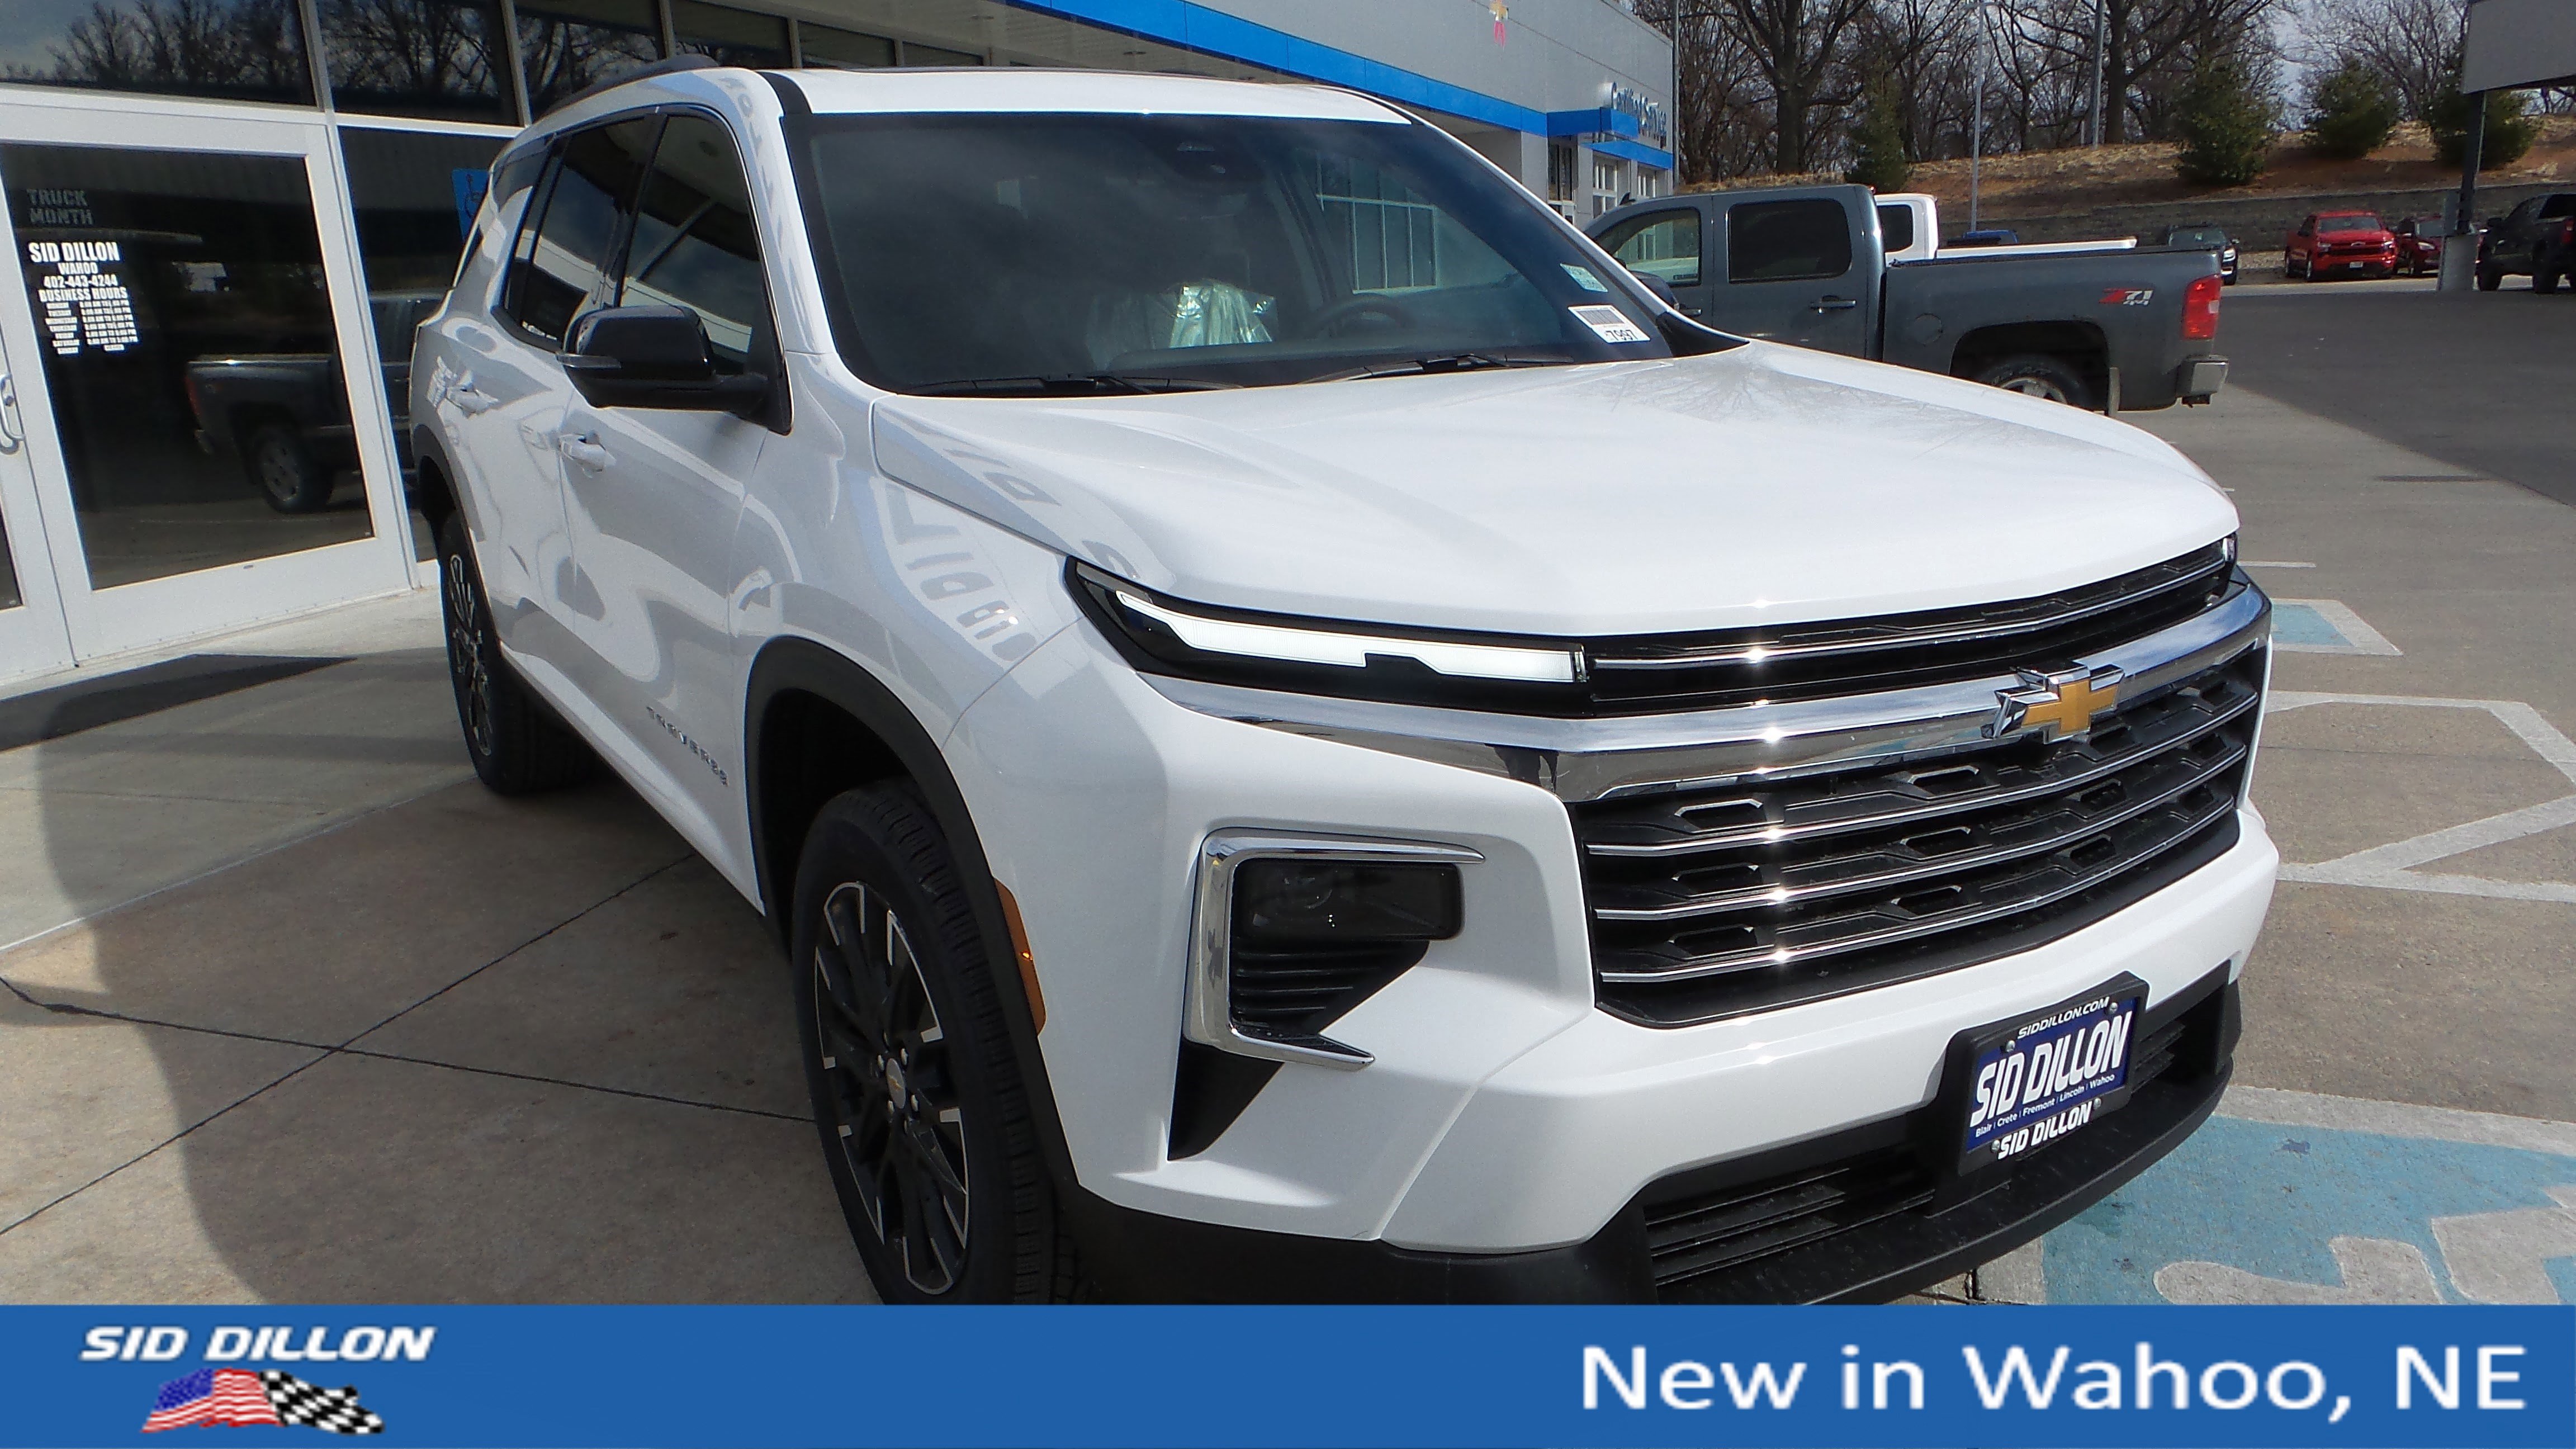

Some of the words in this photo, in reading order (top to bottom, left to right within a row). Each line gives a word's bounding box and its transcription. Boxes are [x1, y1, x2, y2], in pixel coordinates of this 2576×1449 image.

[27, 188, 87, 206] TRUCK
[29, 208, 94, 224] MONTH
[29, 242, 60, 263] SID
[61, 242, 120, 262] DILLON
[58, 262, 98, 274] WAHOO
[44, 274, 118, 288] 402-443-4244
[39, 288, 91, 302] BUSINESS
[92, 287, 128, 300] HOURS
[2017, 997, 2110, 1039] SIDDILLON.COM
[1969, 1052, 2025, 1127] SID
[2023, 1011, 2133, 1105] DILLON
[1975, 1123, 1992, 1137] Blair
[1997, 1114, 2018, 1128] Crete
[2023, 1098, 2056, 1117] Fremont
[2059, 1087, 2085, 1102] Lincoln
[2090, 1074, 2115, 1088] Wahoo
[1998, 1129, 2029, 1160] SID
[2031, 1101, 2092, 1144] DILLON
